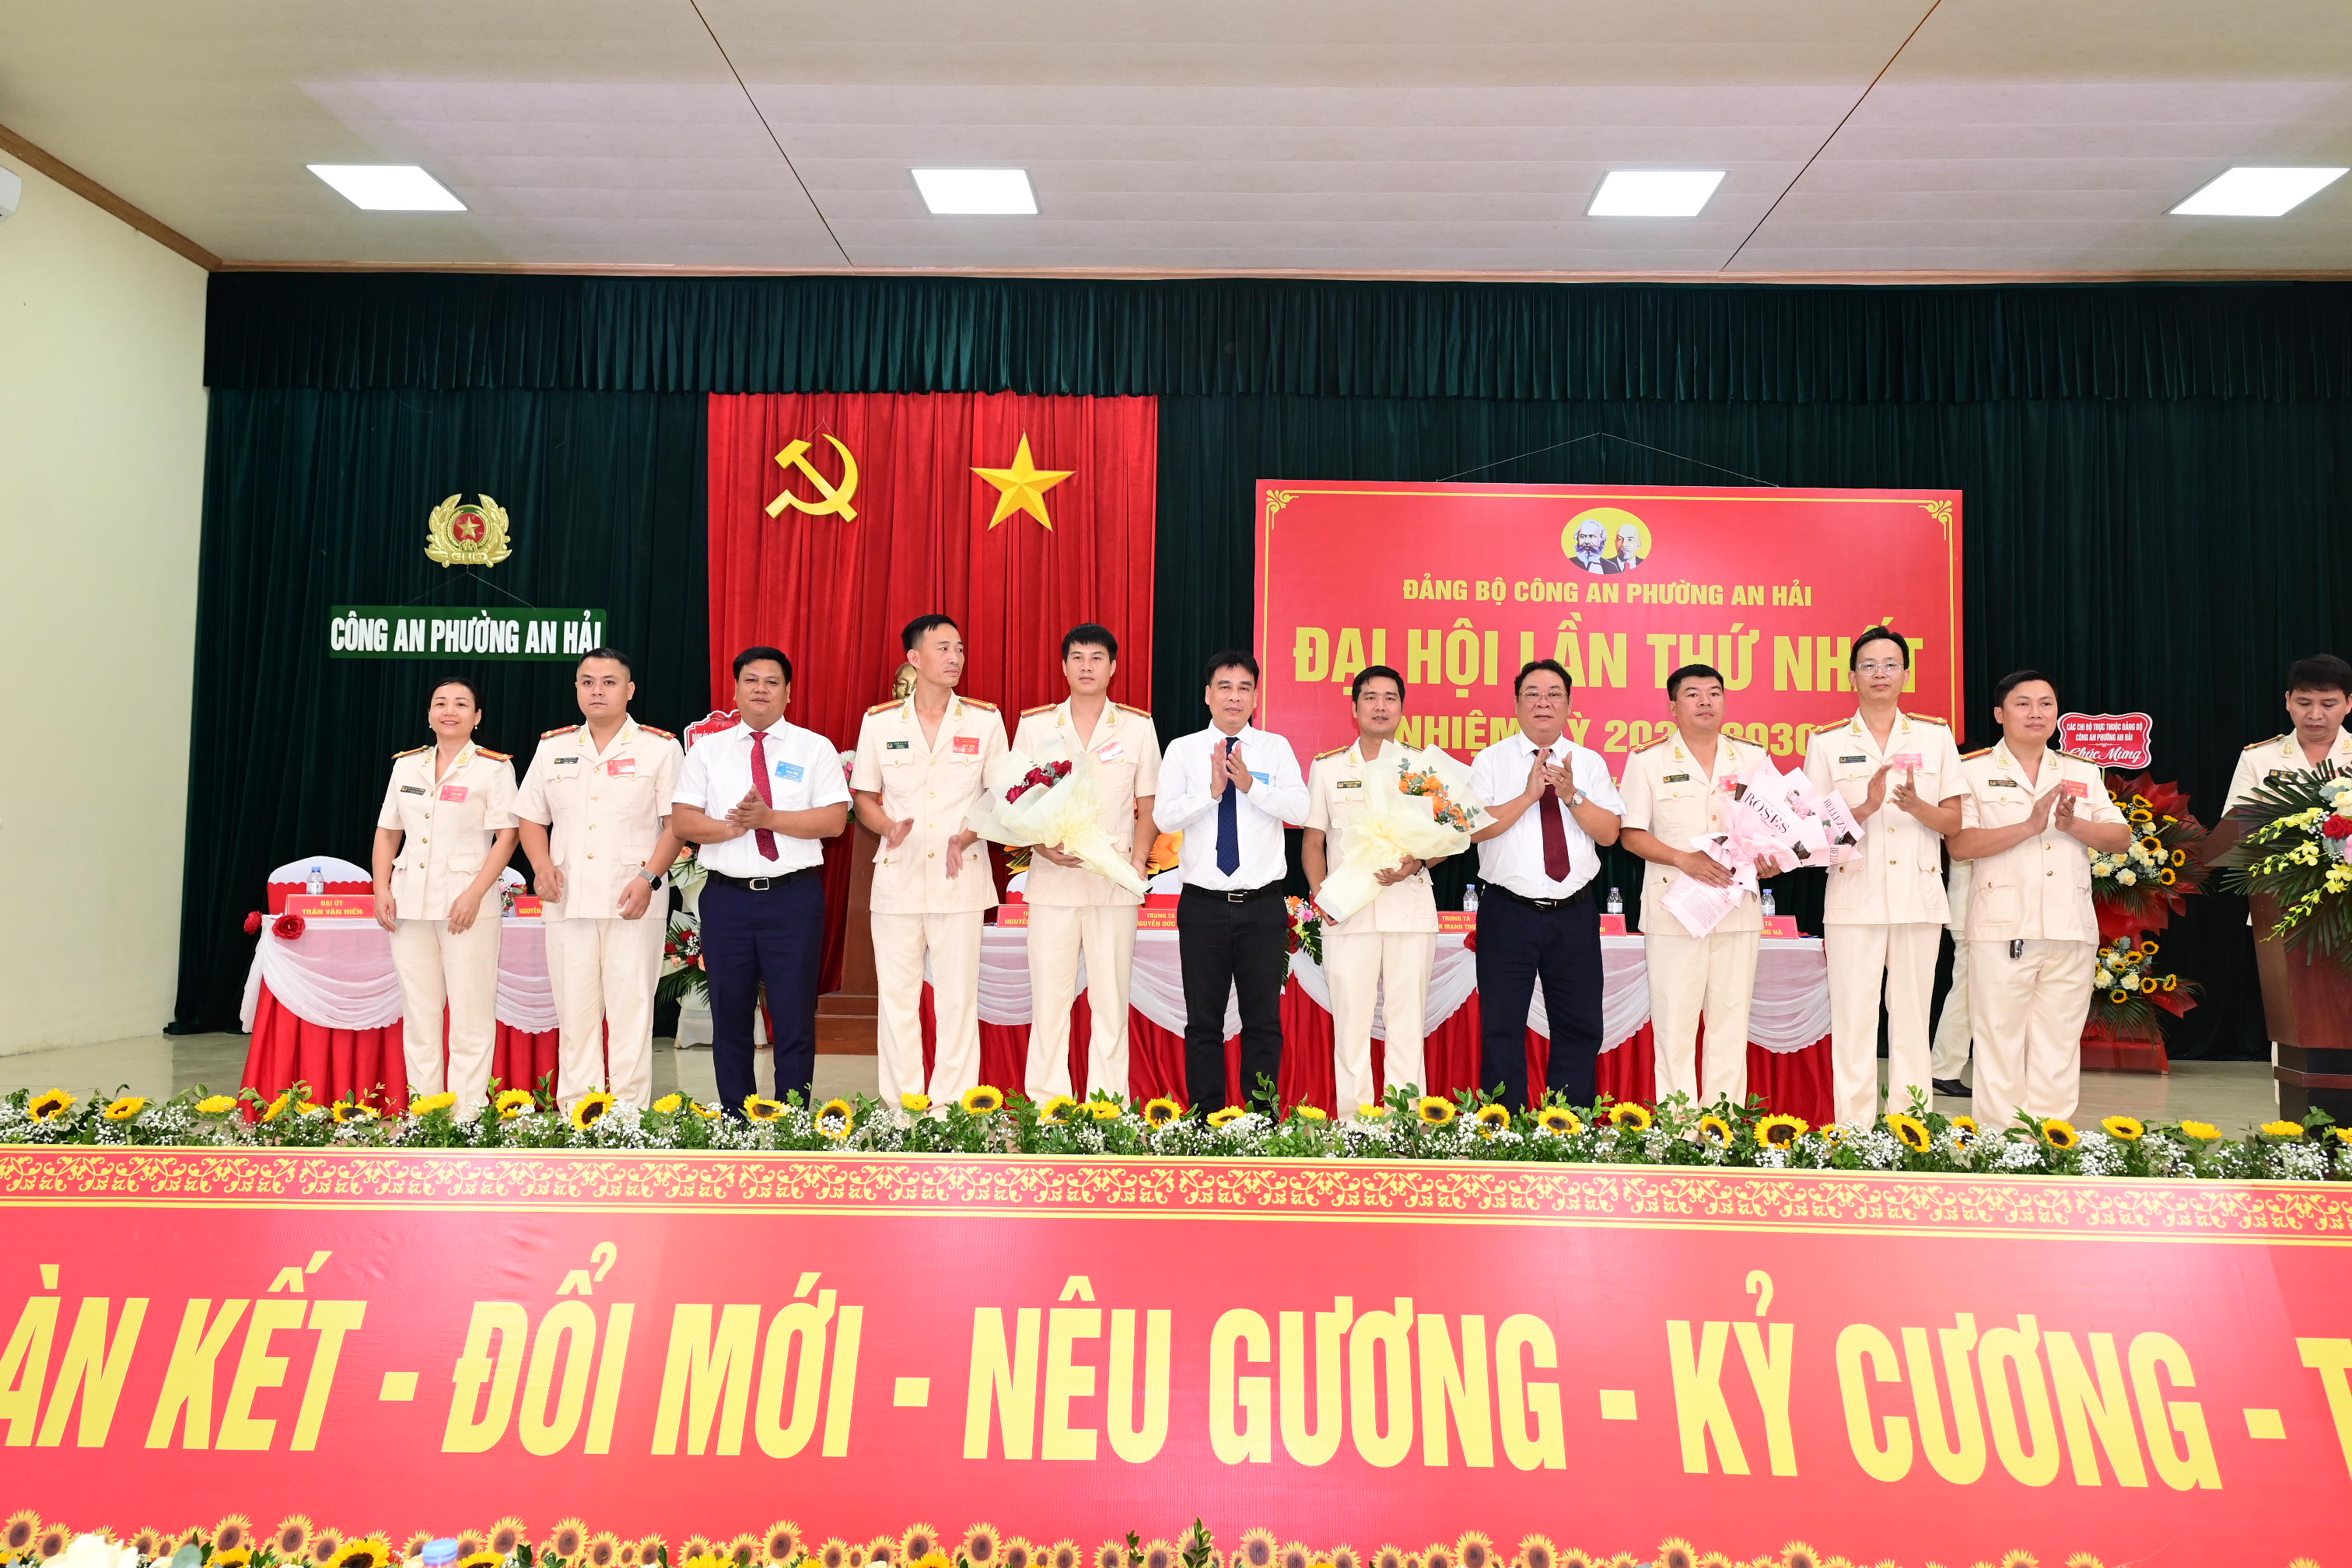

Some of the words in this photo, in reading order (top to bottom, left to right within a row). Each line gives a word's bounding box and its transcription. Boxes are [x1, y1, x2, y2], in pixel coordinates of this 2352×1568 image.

[1402, 572, 1468, 600] ĐẢNG
[1475, 576, 1507, 606] BỘ
[1514, 577, 1579, 603] CÔNG
[1586, 583, 1619, 604] AN
[1628, 579, 1724, 605] PHƯỜNG
[1731, 585, 1765, 606] AN
[1772, 579, 1812, 607] HẢI
[331, 610, 389, 652] CÔNG
[393, 618, 426, 653] AN
[430, 609, 520, 654] PHƯỜNG
[524, 620, 558, 654] AN
[563, 609, 602, 654] HẢI
[1293, 626, 1387, 695] ĐẠI
[1407, 618, 1499, 698] HỘI
[1773, 617, 1924, 694] NHT
[2067, 722, 2077, 731] CÁC
[2077, 723, 2085, 731] CHI
[2075, 732, 2088, 741] CÔNG
[2096, 732, 2116, 741] PHƯỜNG
[2099, 746, 2142, 764] Mừng
[1743, 792, 1790, 835] ROSES
[1137, 919, 1160, 927] GUYỄN
[144, 1250, 368, 1452] KẾT
[441, 1241, 635, 1456] ĐỔI
[651, 1272, 864, 1459] MỚI
[963, 1276, 1171, 1464] NÊU
[1209, 1296, 1567, 1472] GƯƠNG
[1666, 1269, 1799, 1477] KỶ
[1836, 1312, 2224, 1491] CƯƠNG
